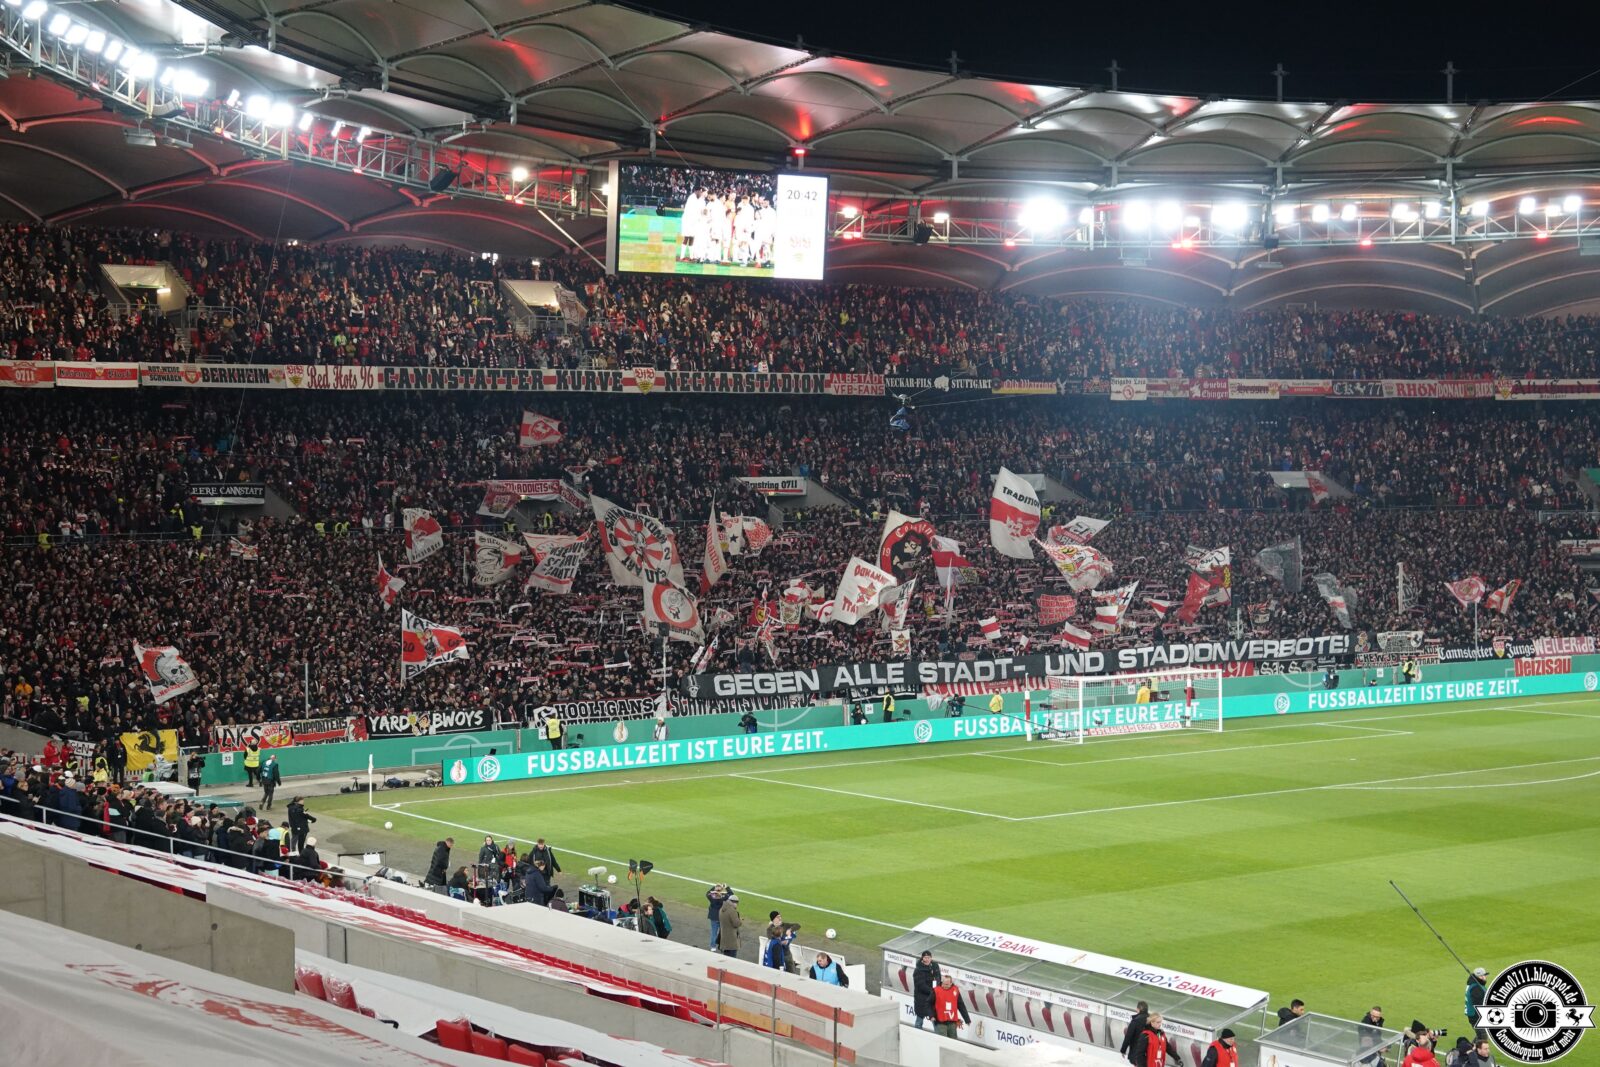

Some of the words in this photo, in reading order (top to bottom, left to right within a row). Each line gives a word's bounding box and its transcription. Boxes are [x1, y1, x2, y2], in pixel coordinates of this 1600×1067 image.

[787, 190, 818, 201] 20:42
[150, 374, 182, 382] SCHWABEN
[201, 367, 270, 384] BERKHEIM
[307, 365, 331, 389] Red
[333, 365, 359, 389] Hots
[360, 366, 374, 388] 96
[384, 367, 544, 391] CANNSTATTER
[556, 369, 623, 392] KURVE
[664, 371, 825, 394] NECKARSTADION
[833, 374, 885, 385] ALBSTADT
[886, 377, 932, 389] NECKAR-FILS
[951, 378, 993, 390] STUTTGART
[833, 385, 885, 396] VFB-FANS
[1438, 383, 1465, 398] DONAU
[1475, 383, 1494, 397] RIES
[219, 487, 264, 497] CANNSTATT
[781, 480, 798, 489] 0711
[1437, 642, 1494, 661] Cannstatter
[1504, 641, 1536, 658] Jungs
[713, 669, 820, 697] GEGEN
[833, 662, 905, 688] ALLE
[918, 658, 1026, 685] STADT-
[1044, 651, 1105, 675] UND
[1118, 634, 1350, 670] STADIONVERBOTE!
[1514, 656, 1572, 677] Deizisau
[1308, 685, 1416, 710] FUSSBALLZEIT
[1420, 684, 1442, 701] IST
[1446, 682, 1483, 699] EURE
[1487, 678, 1523, 696] ZEIT.
[554, 697, 655, 720] HOOLIGANS
[369, 714, 409, 733] YARD
[432, 708, 484, 727] BWOYS
[953, 711, 1081, 738] FUSSBALLZEIT
[1085, 707, 1111, 728] IST
[1114, 704, 1162, 724] EURE
[1160, 722, 1180, 730] ERGO
[527, 743, 680, 775] FUSSBALLZEIT
[687, 739, 718, 760] IST
[723, 734, 775, 757] EURE
[781, 730, 829, 753] ZEIT.
[946, 928, 990, 945] TARGO
[998, 940, 1039, 956] BANK
[1114, 965, 1164, 985] TARGO
[1175, 980, 1223, 998] BANK
[996, 1029, 1026, 1047] TARGO
